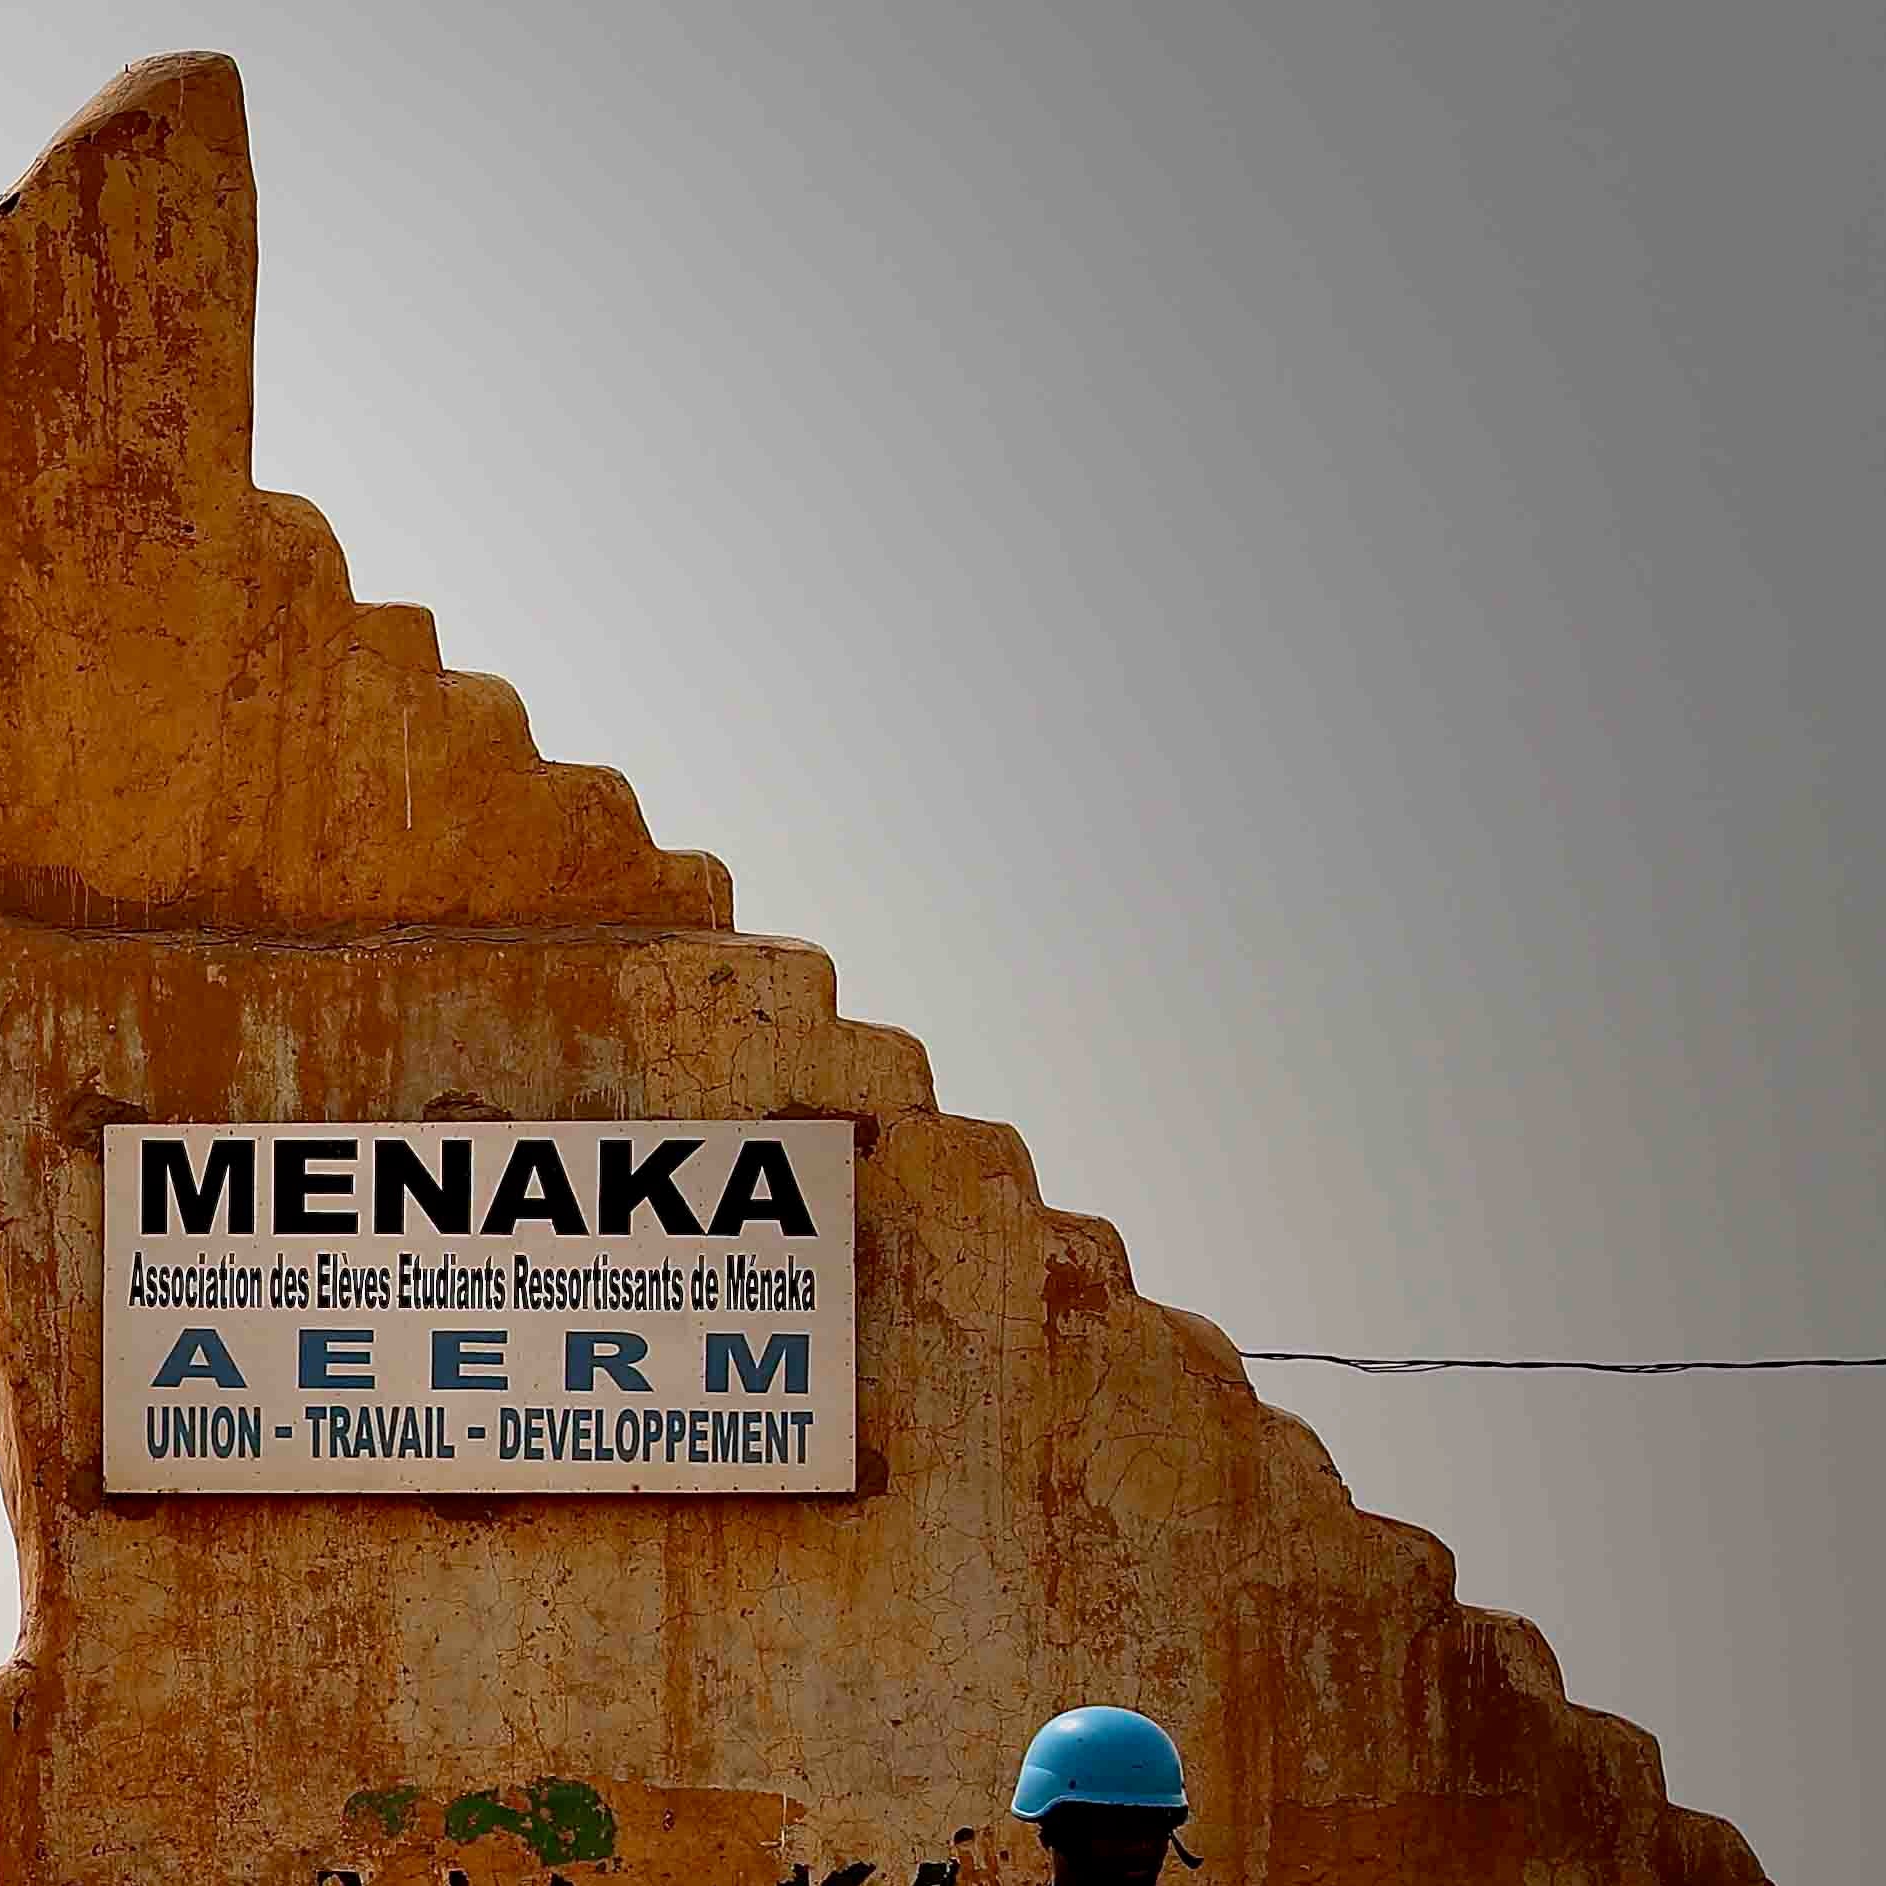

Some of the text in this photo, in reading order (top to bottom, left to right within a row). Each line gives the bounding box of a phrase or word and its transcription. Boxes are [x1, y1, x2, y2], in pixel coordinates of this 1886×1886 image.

[141, 1139, 819, 1238] MENAKA
[129, 1251, 816, 1312] Association des Elèves Etudiants Ressortissants de Ménaka
[146, 1405, 261, 1460] UNION
[304, 1405, 455, 1459] TRAVAIL
[499, 1407, 814, 1465] DEVELOPPEMENT
